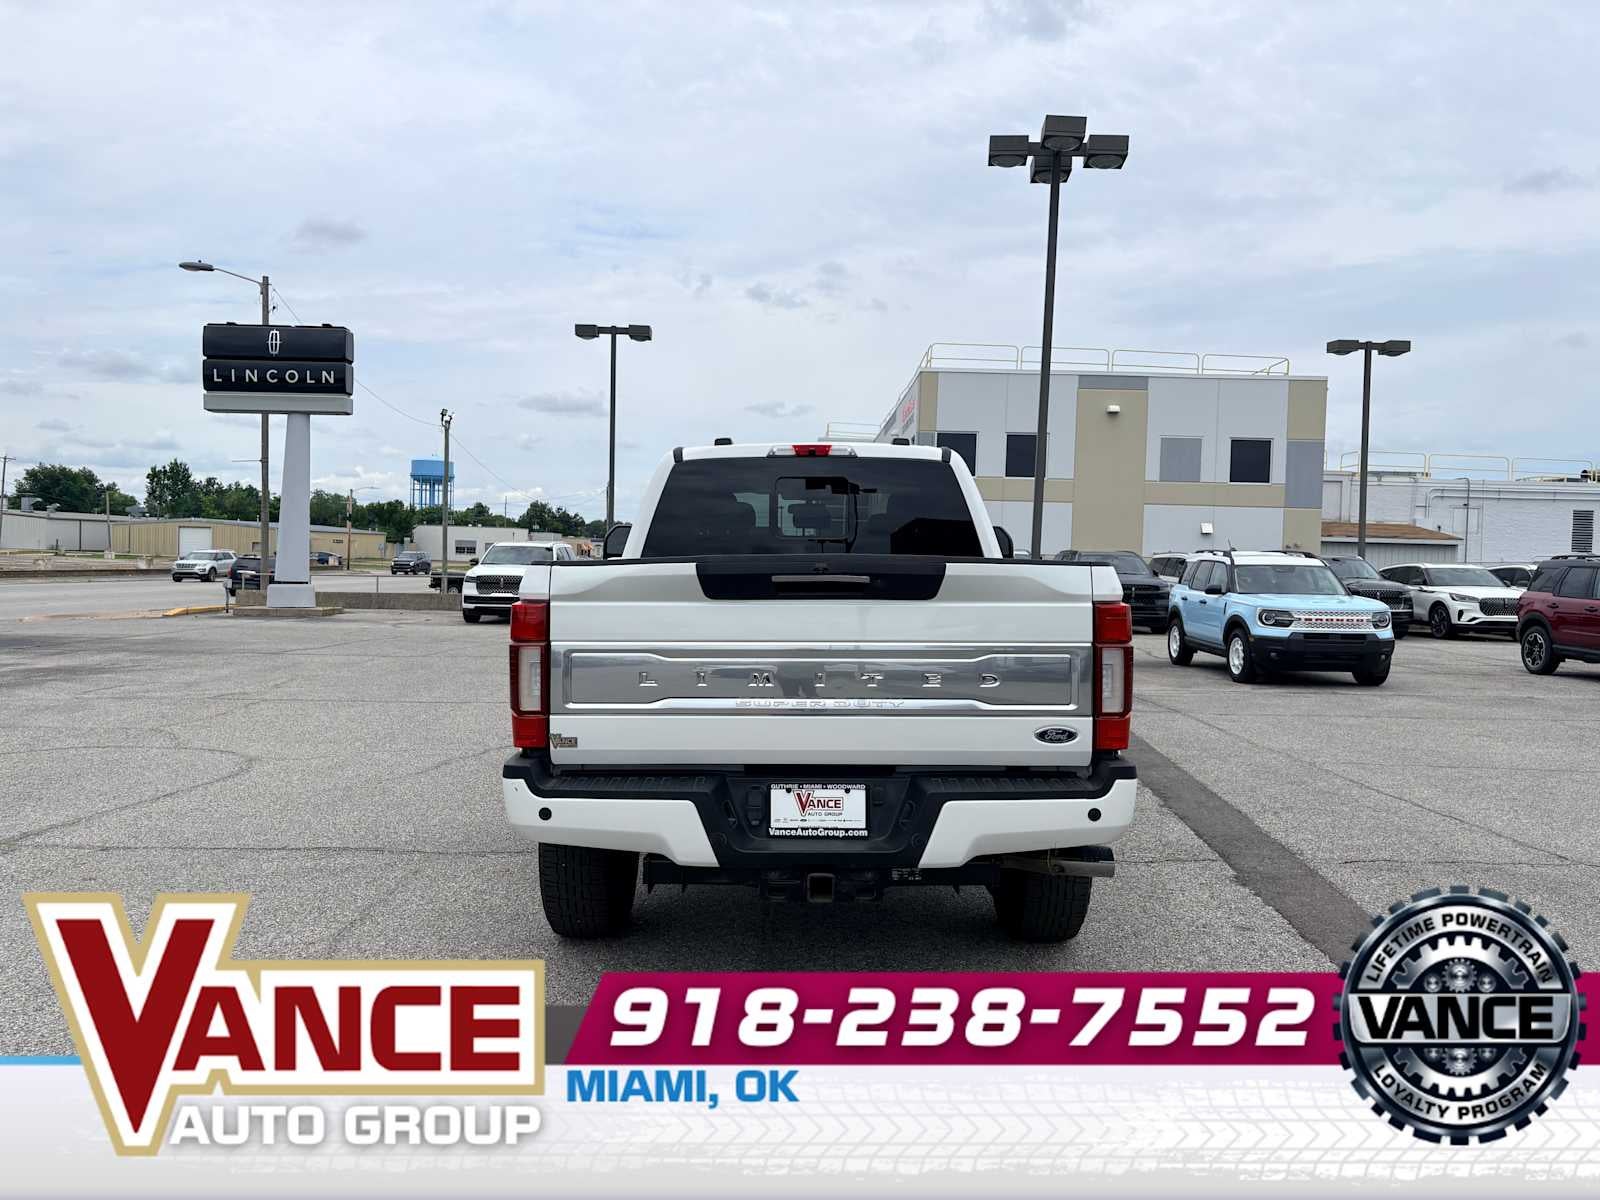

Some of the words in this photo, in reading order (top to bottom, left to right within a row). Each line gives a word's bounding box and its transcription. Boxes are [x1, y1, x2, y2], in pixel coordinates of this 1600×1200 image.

[213, 368, 335, 384] LINCOLN
[638, 671, 1000, 687] LIMITED
[736, 700, 825, 708] SUPER
[833, 700, 904, 708] DUTY
[795, 792, 842, 814] VANCE
[769, 828, 868, 838] VanceAutoGroup.com
